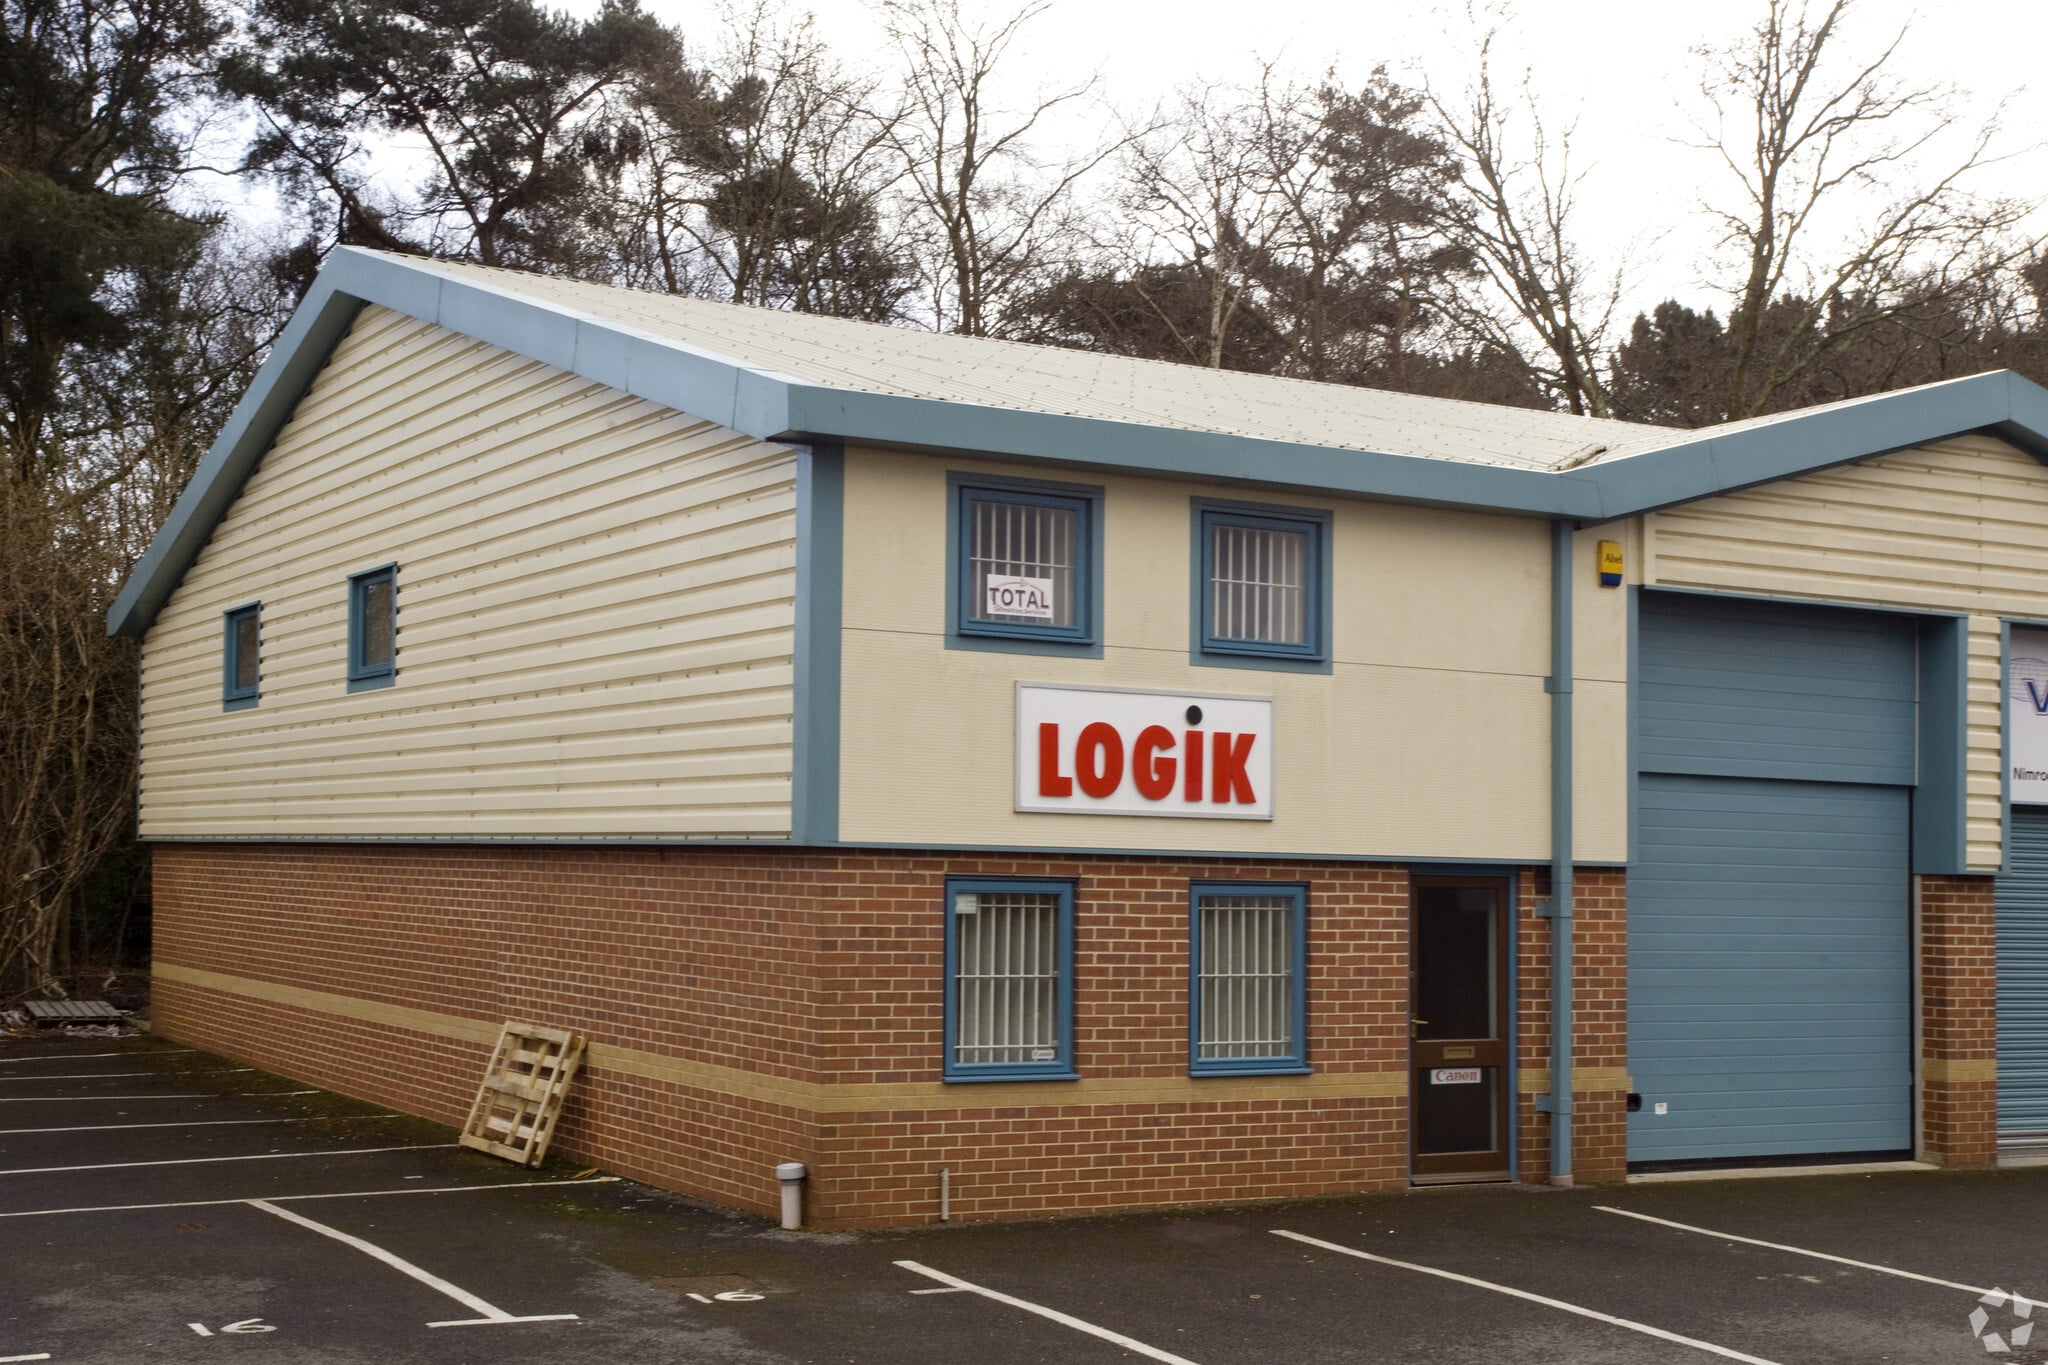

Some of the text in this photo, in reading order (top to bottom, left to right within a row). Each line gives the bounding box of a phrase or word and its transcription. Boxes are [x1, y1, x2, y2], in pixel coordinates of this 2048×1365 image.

[989, 587, 1050, 609] TOTAL
[1435, 1070, 1478, 1082] Canon
[686, 1288, 766, 1304] 16
[187, 1317, 278, 1337] 16
